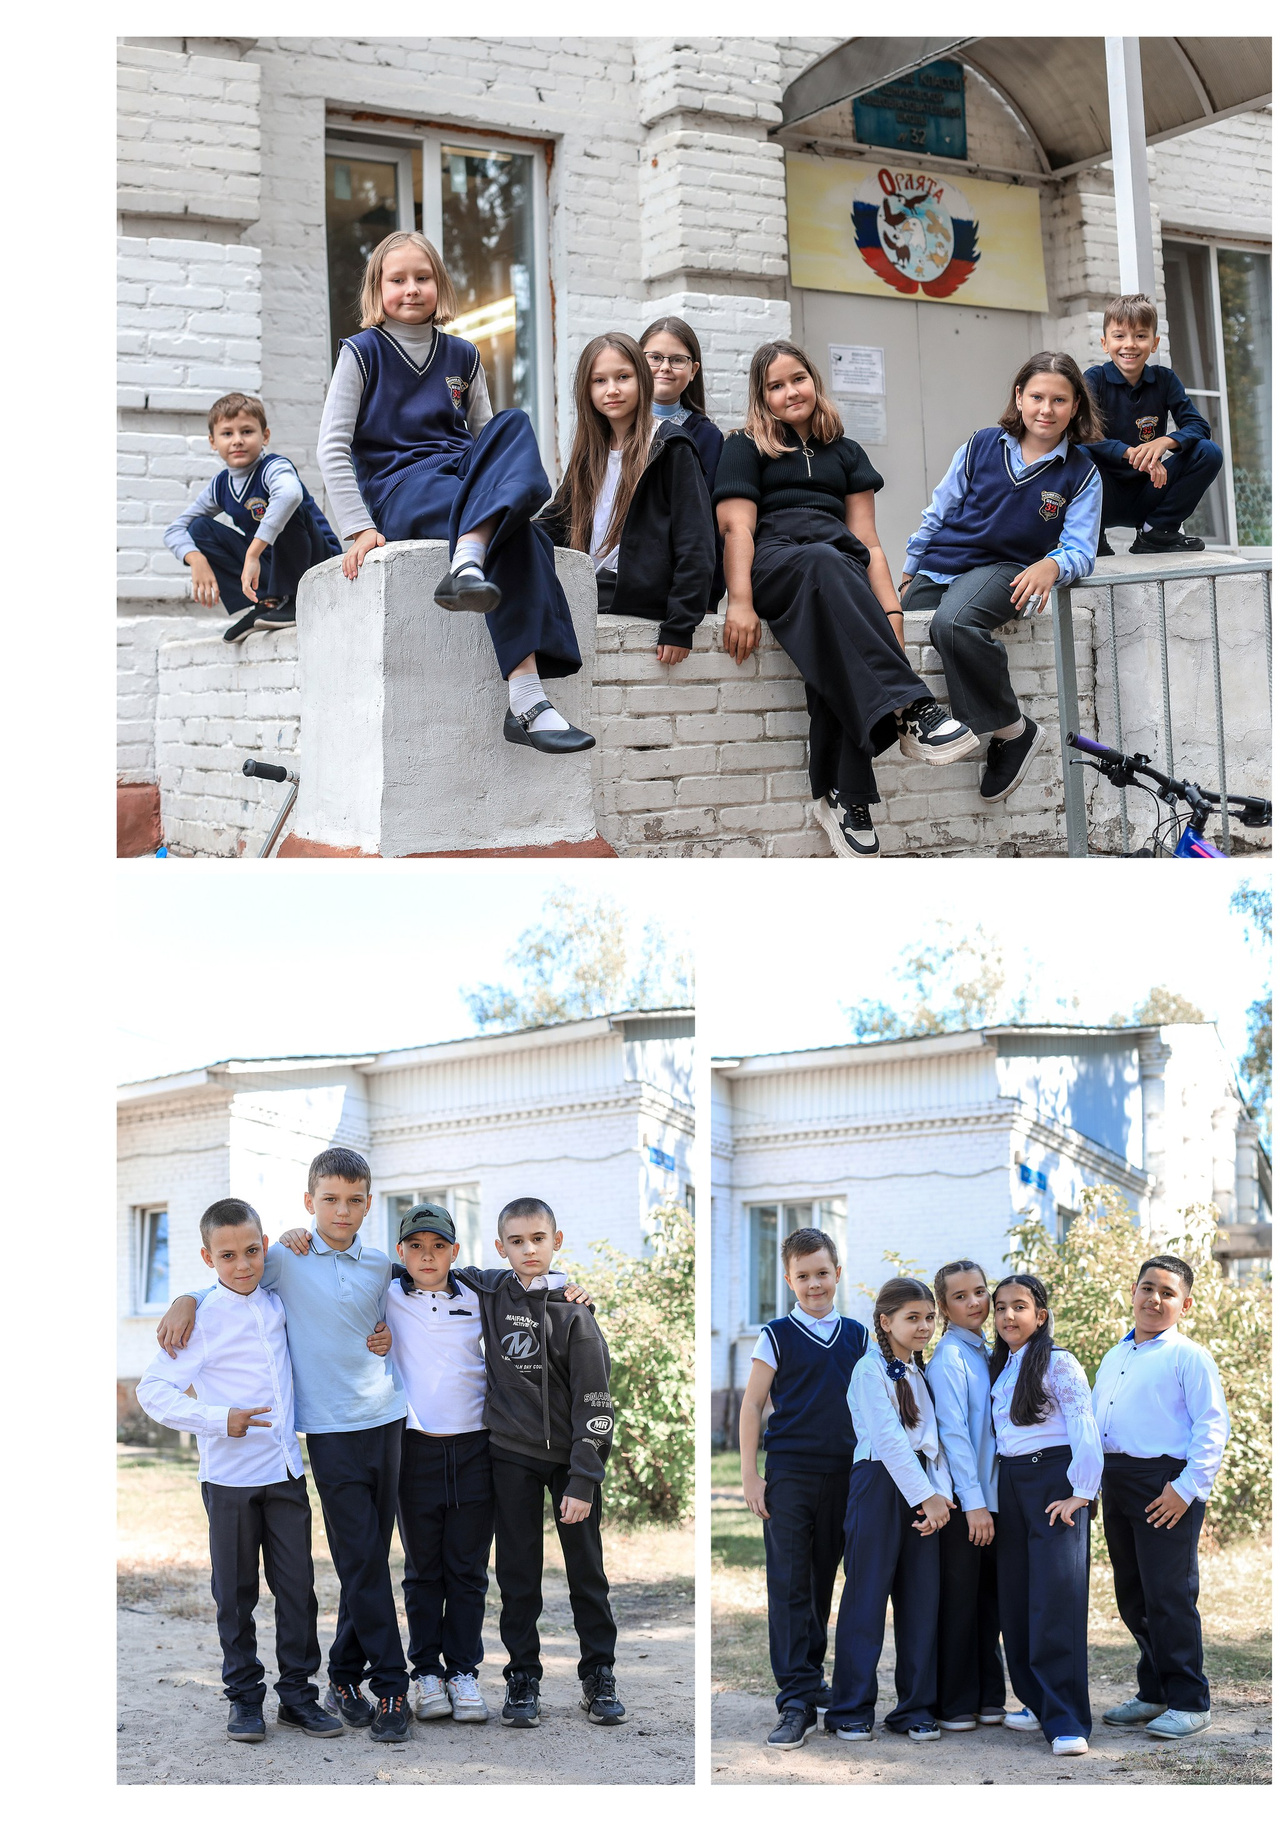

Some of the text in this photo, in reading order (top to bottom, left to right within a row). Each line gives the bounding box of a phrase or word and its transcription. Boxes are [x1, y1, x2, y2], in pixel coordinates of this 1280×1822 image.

[910, 127, 927, 145] 32
[1045, 503, 1057, 513] 32
[593, 1420, 608, 1429] MR
